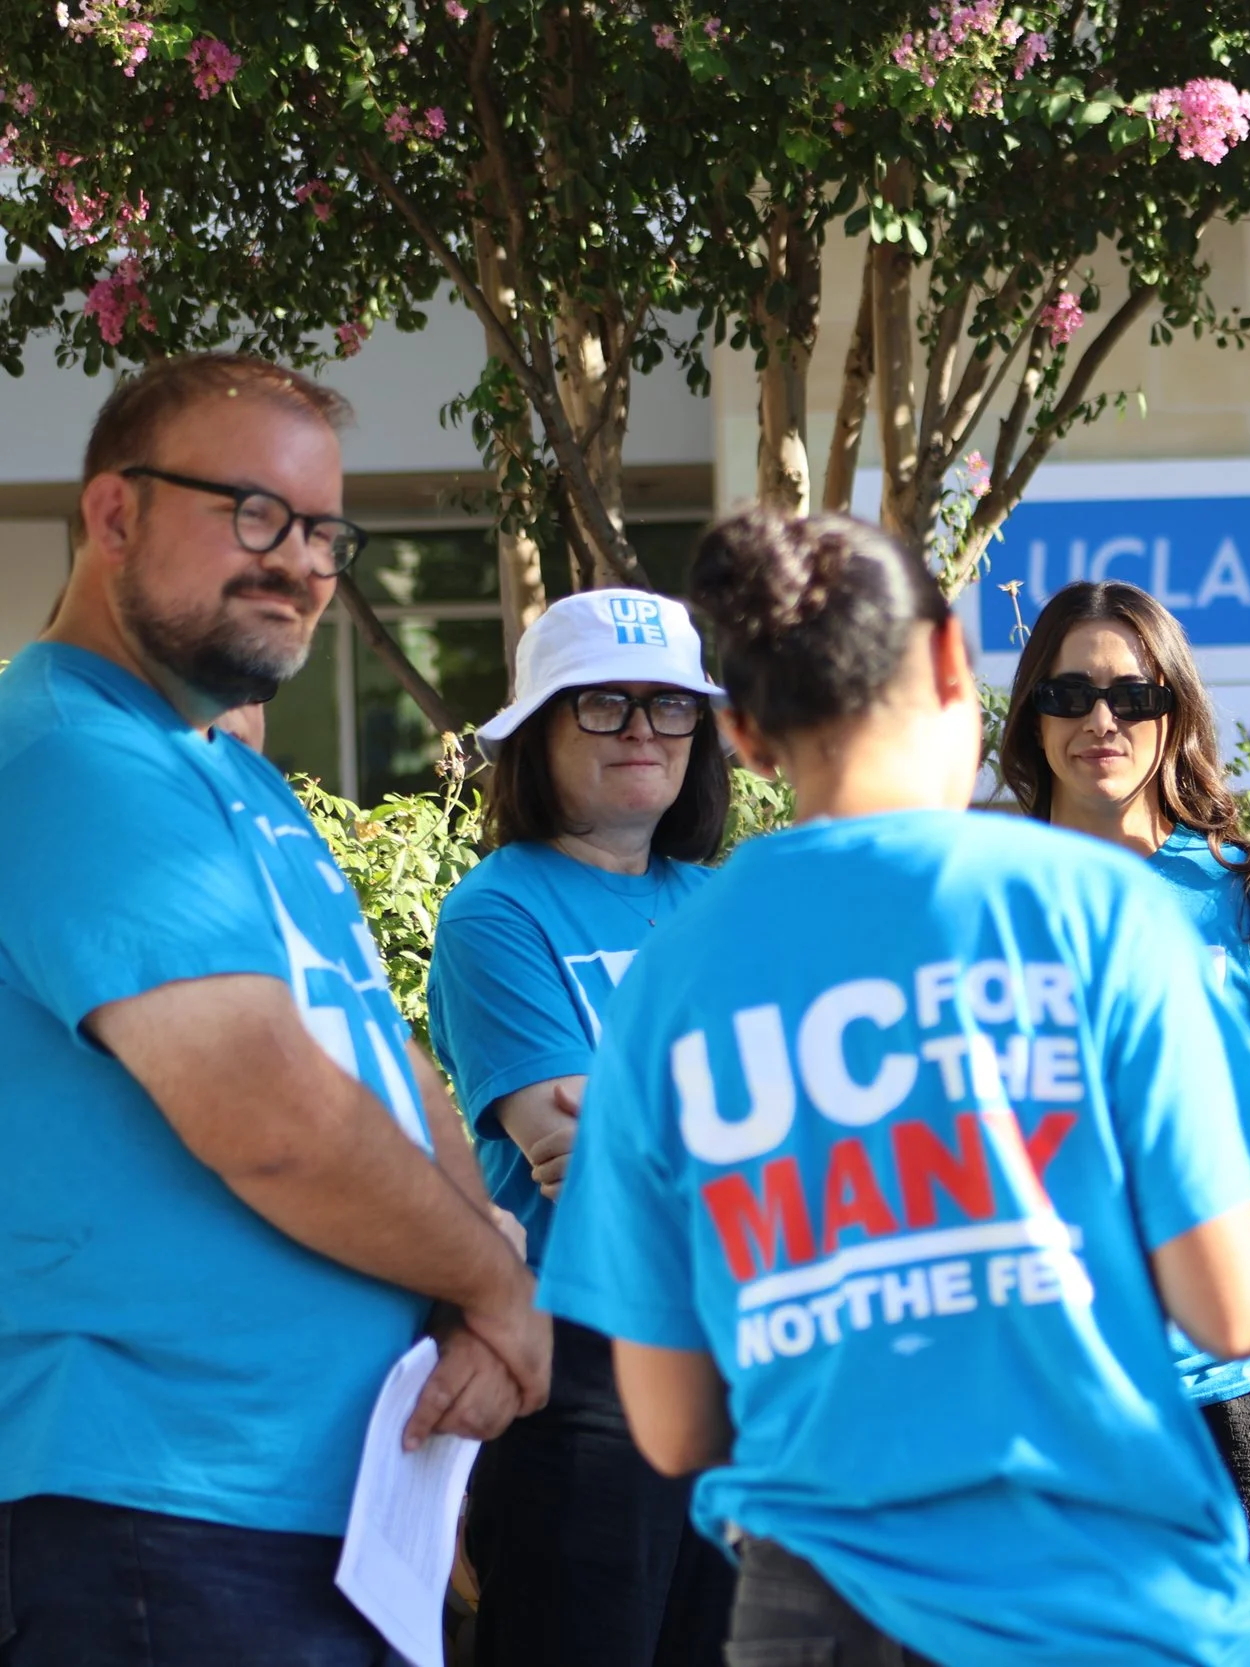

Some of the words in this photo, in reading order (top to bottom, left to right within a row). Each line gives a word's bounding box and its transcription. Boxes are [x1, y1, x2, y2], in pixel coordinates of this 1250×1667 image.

[613, 600, 658, 623] UP
[617, 622, 666, 645] TE
[914, 958, 1078, 1028] FOR
[671, 978, 919, 1165] UC
[921, 1033, 1085, 1102] THE
[701, 1111, 1079, 1283] MANY
[736, 1293, 842, 1369] NOT
[841, 1260, 977, 1330] THE
